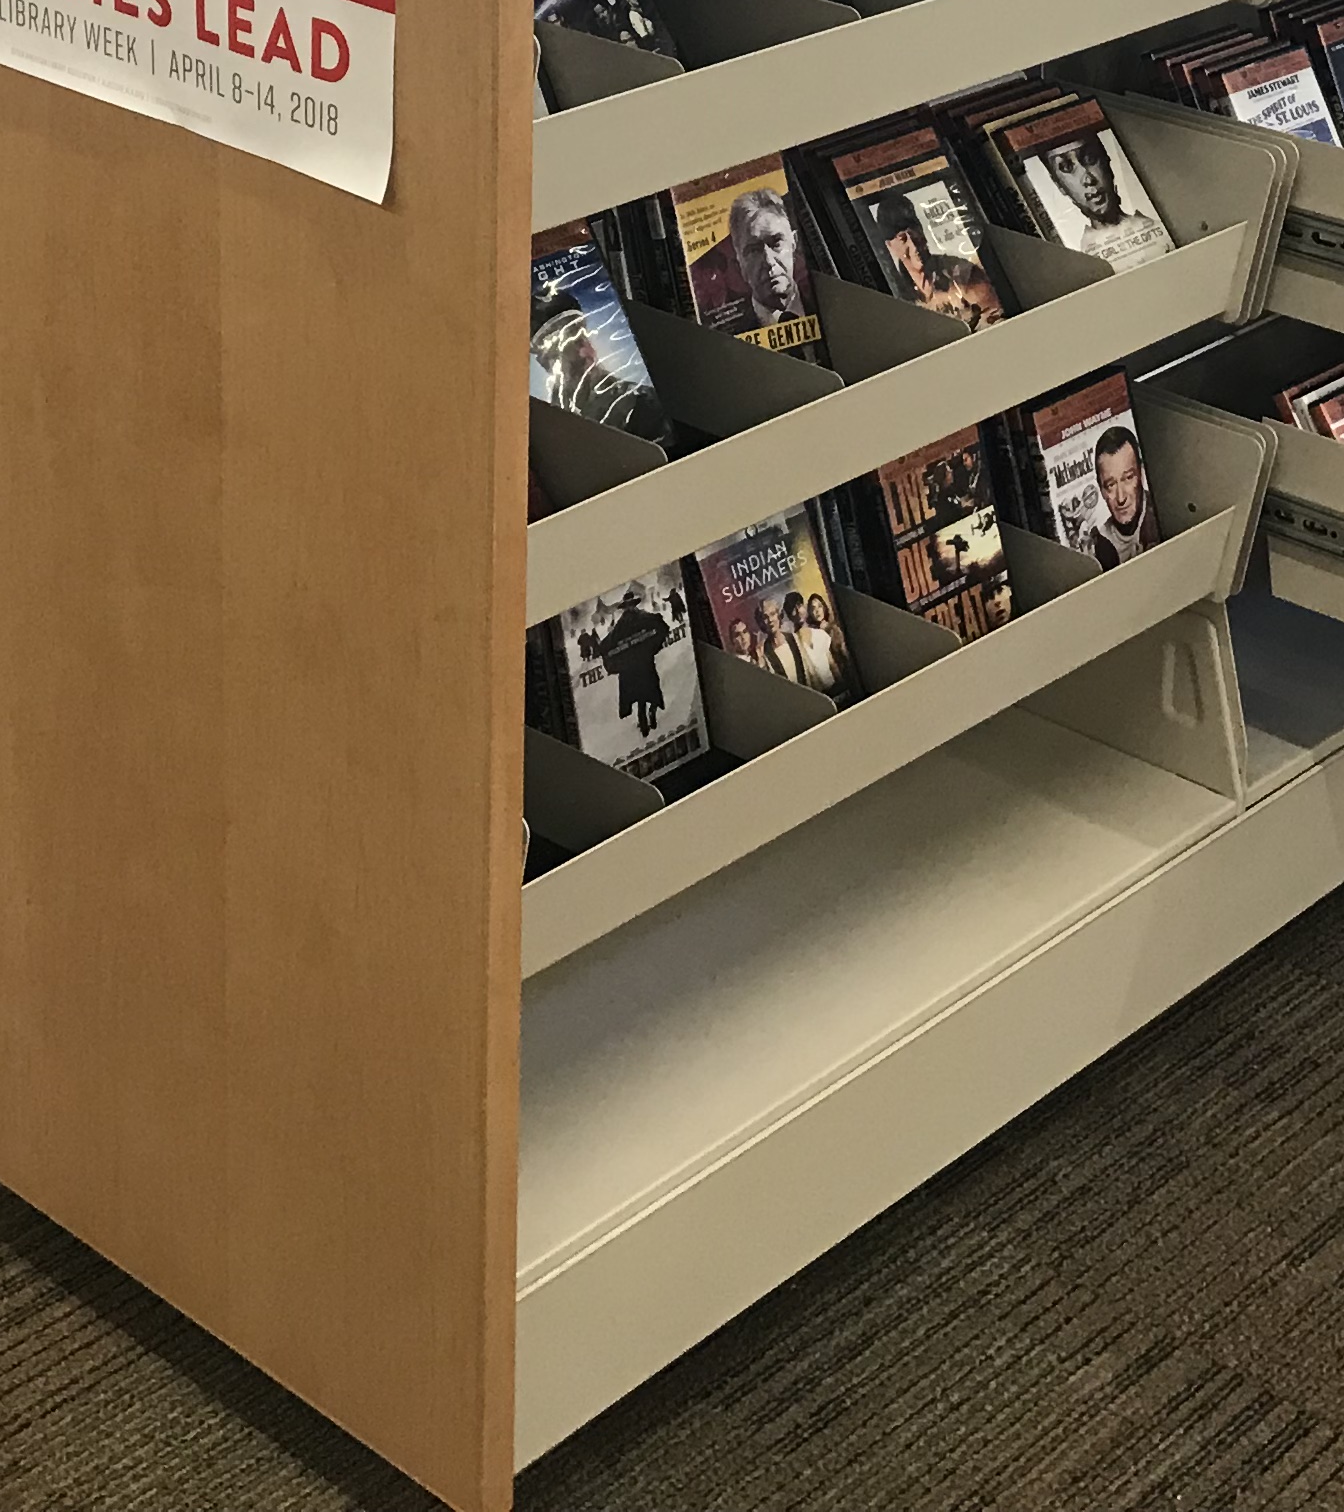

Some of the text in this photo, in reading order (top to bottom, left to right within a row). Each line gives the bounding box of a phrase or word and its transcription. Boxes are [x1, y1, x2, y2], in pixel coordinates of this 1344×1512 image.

[84, 20, 137, 66] WEEK
[168, 50, 224, 98] APRIL
[231, 72, 283, 122] 8-14,
[290, 94, 339, 136] 2018
[1270, 74, 1300, 93] STEWART
[1290, 99, 1320, 120] LOUIS
[686, 231, 717, 253] Series 4
[1126, 236, 1144, 253] THE
[1140, 226, 1164, 245] GIFTS
[767, 320, 819, 350] GENTLY
[1060, 407, 1113, 440] JOHN WAYNE
[880, 463, 937, 536] LIVE
[731, 540, 789, 580] INDIAN
[897, 538, 940, 605] DIE
[722, 550, 808, 604] SUMMERS
[580, 665, 605, 688] THE
